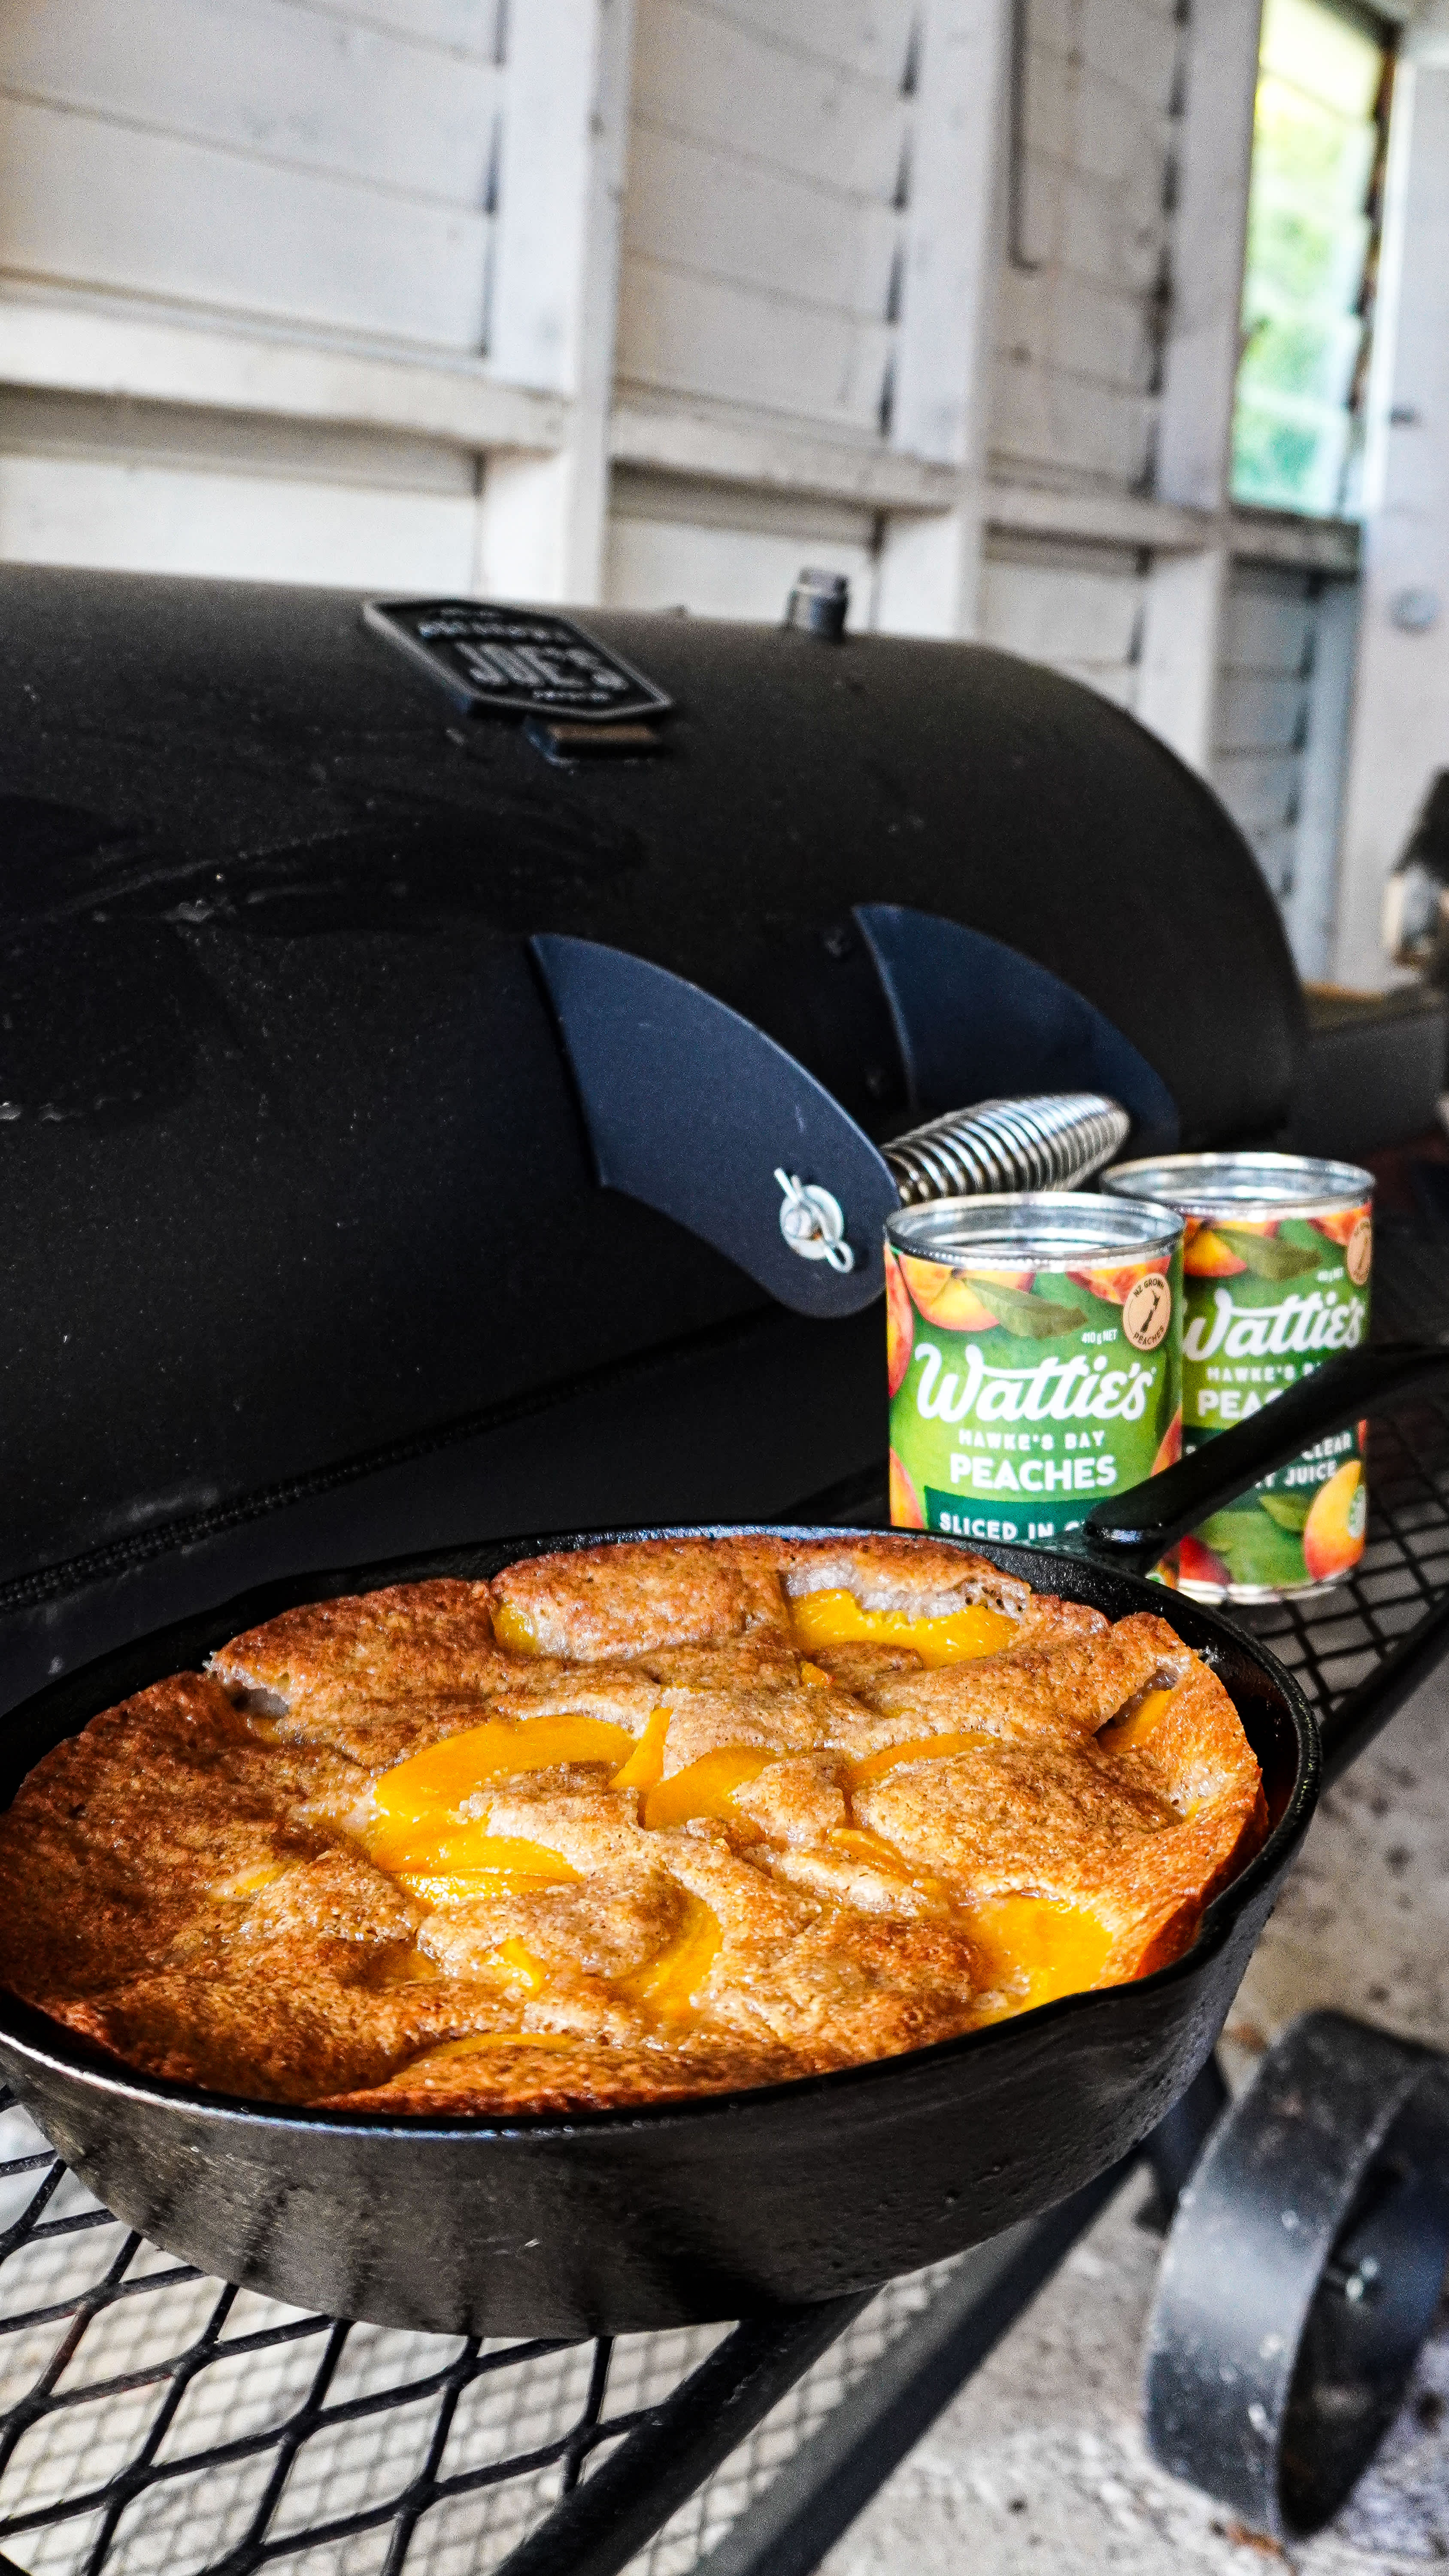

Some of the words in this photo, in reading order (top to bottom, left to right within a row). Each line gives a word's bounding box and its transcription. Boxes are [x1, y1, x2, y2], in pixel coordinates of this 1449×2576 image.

[1133, 1325, 1164, 1345] PEACHES
[915, 1343, 1153, 1423] Wattie's
[958, 1429, 1054, 1451] HAWKE'S
[1065, 1430, 1105, 1450] BAY
[950, 1452, 1117, 1491] PEACHES
[1285, 1459, 1337, 1486] JUICE
[939, 1511, 1018, 1540] SLICED
[1028, 1522, 1054, 1540] IN
